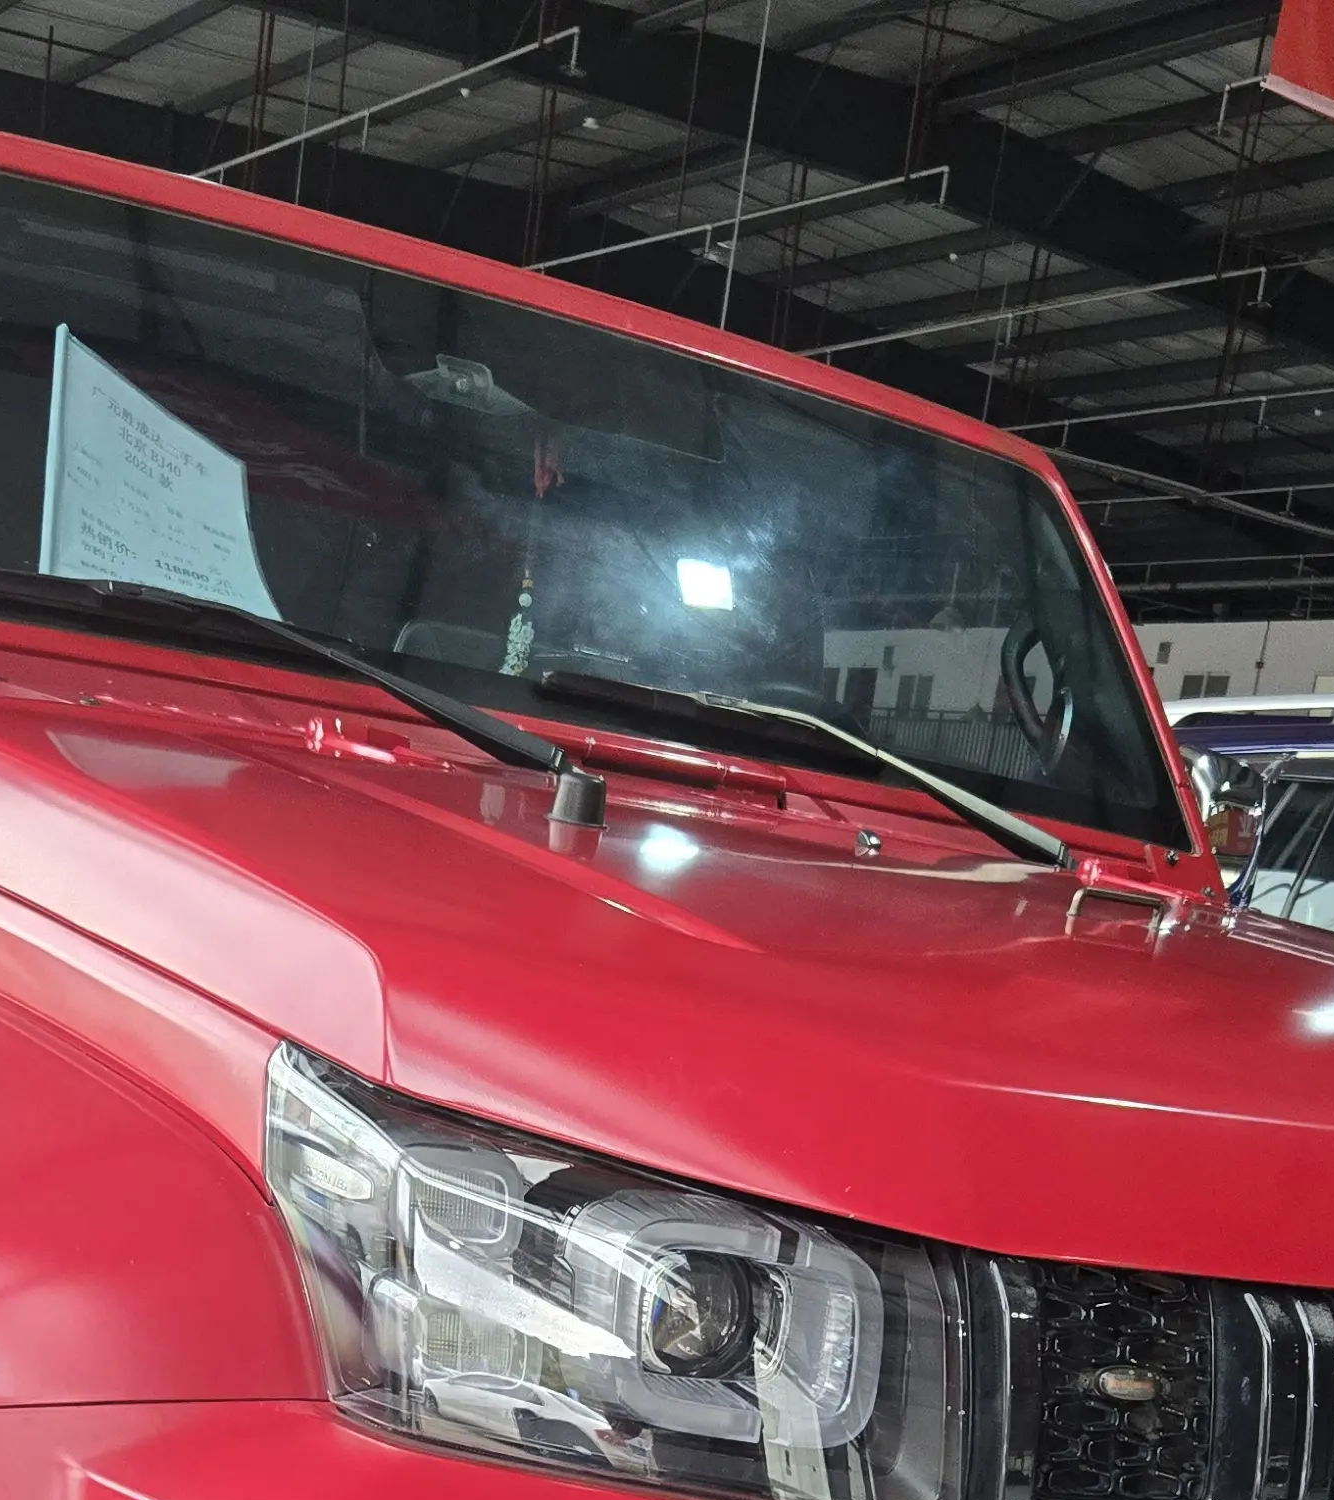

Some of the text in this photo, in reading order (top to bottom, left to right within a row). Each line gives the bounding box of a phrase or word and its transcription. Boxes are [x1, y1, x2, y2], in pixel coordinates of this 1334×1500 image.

[118, 426, 148, 457] 北京
[151, 449, 182, 478] BJ40
[124, 450, 154, 479] 2021
